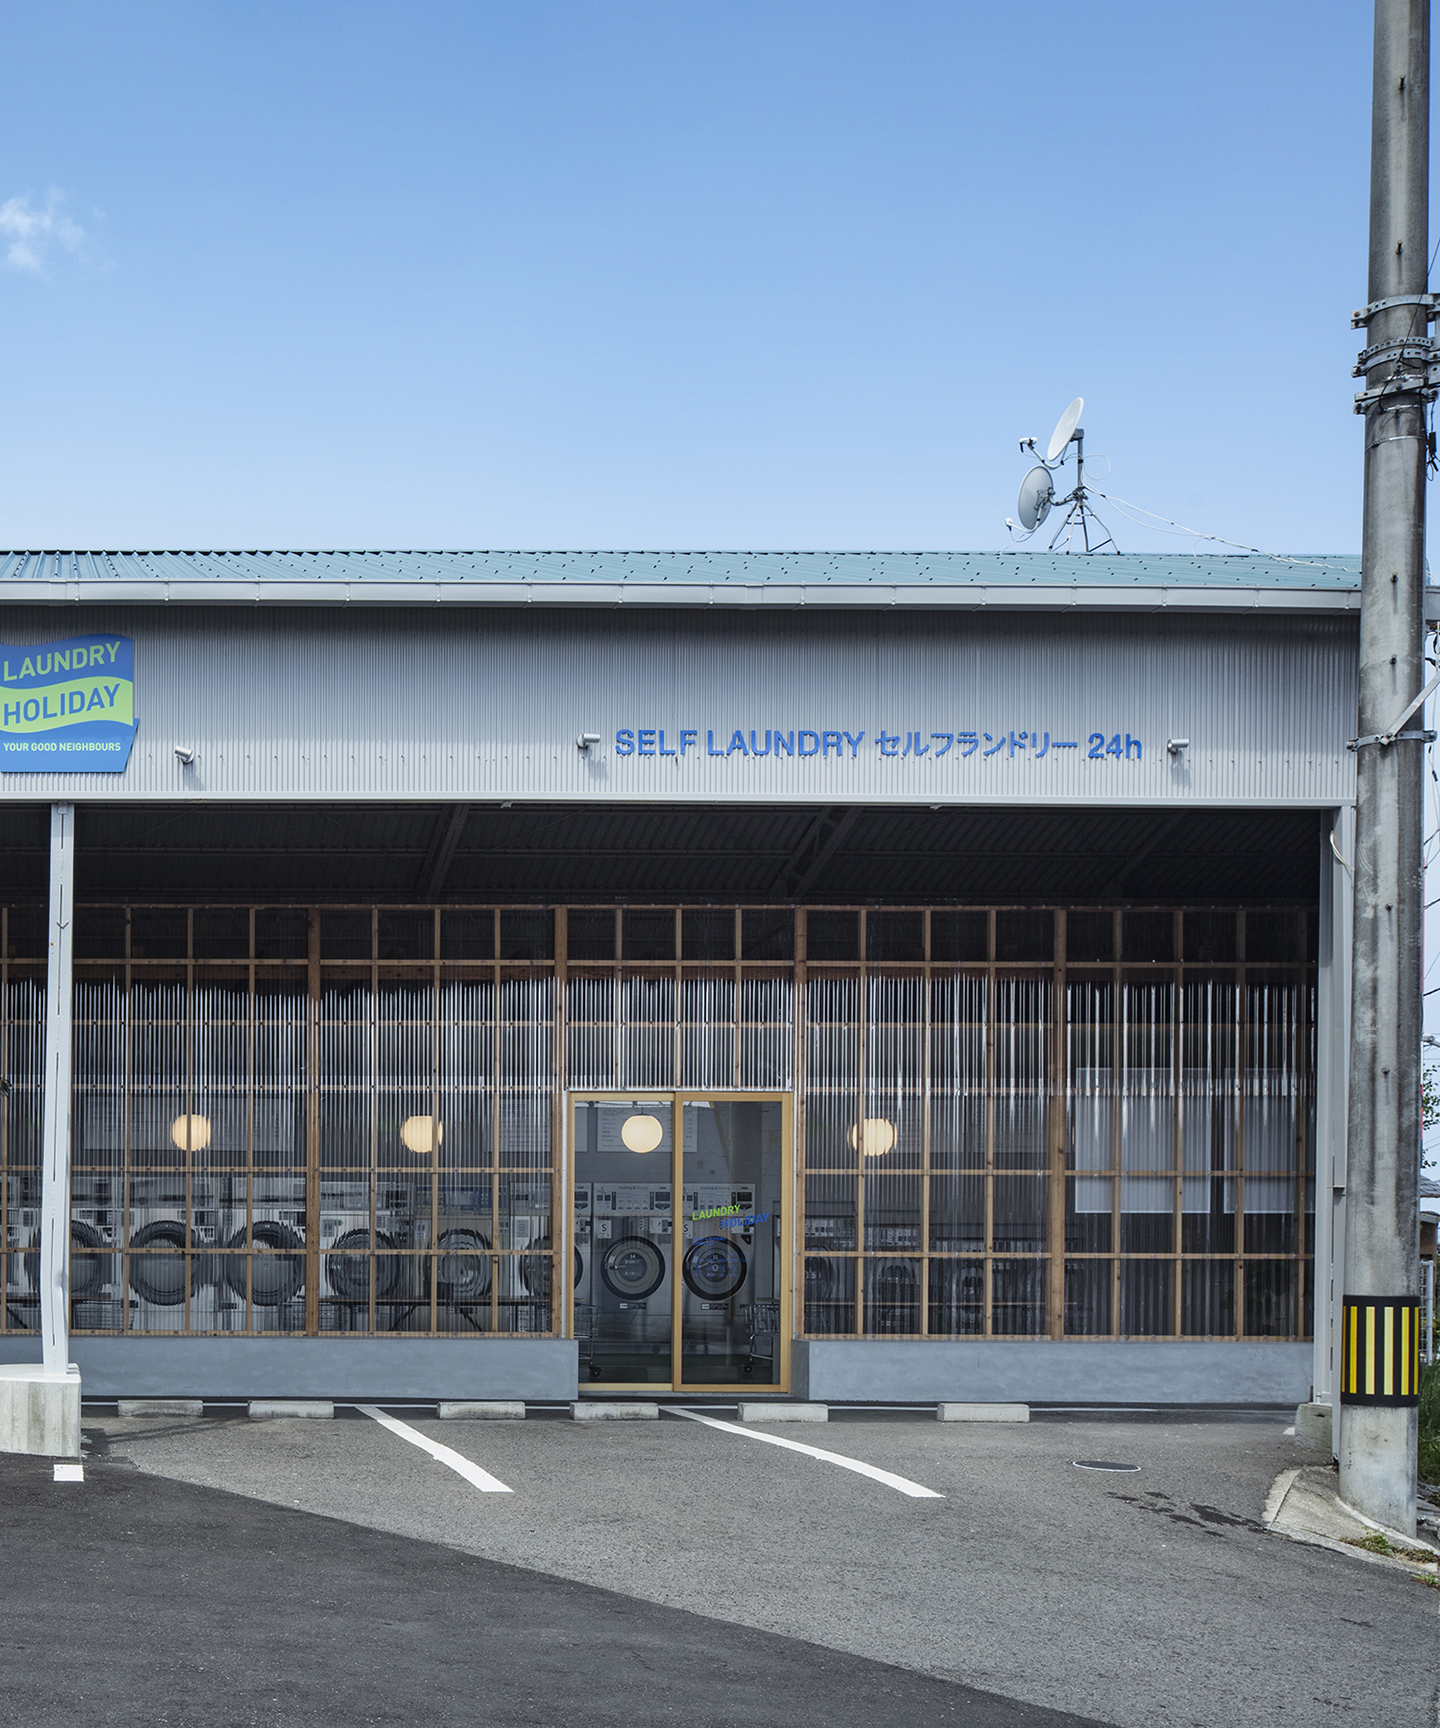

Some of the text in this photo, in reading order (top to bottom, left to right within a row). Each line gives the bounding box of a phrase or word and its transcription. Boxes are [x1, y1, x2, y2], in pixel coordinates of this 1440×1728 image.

[4, 641, 120, 681] LAUNDRY
[4, 683, 120, 726] HOLIDAY
[3, 742, 121, 752] YOUR GOOD NEIGHBOURS
[615, 729, 1142, 759] SELF LAUNDRY セルフランドリー 24h
[692, 1204, 741, 1221] LAUNDRY
[721, 1212, 770, 1230] HOLIDAY
